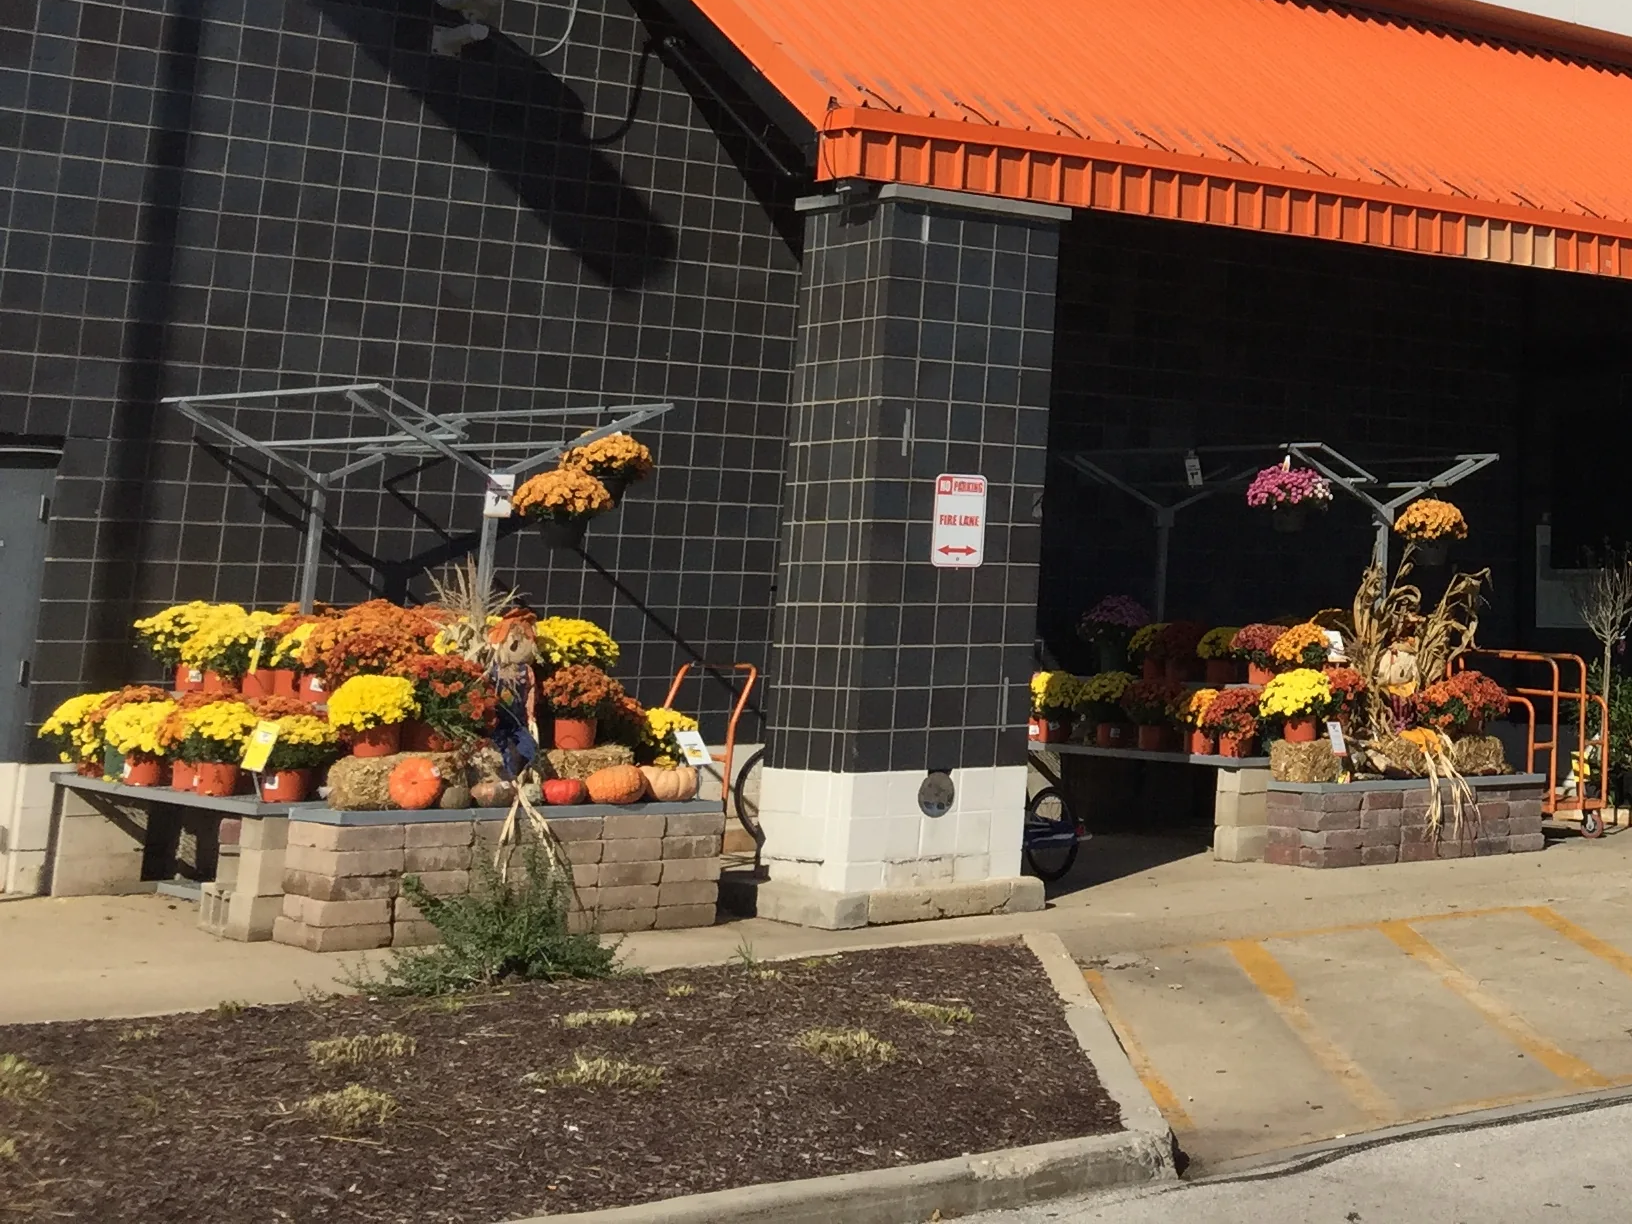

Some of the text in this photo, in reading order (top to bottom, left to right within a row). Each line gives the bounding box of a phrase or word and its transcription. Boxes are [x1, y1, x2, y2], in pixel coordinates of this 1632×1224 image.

[940, 480, 983, 493] NO PARKING
[940, 515, 979, 527] FIRE LANE
